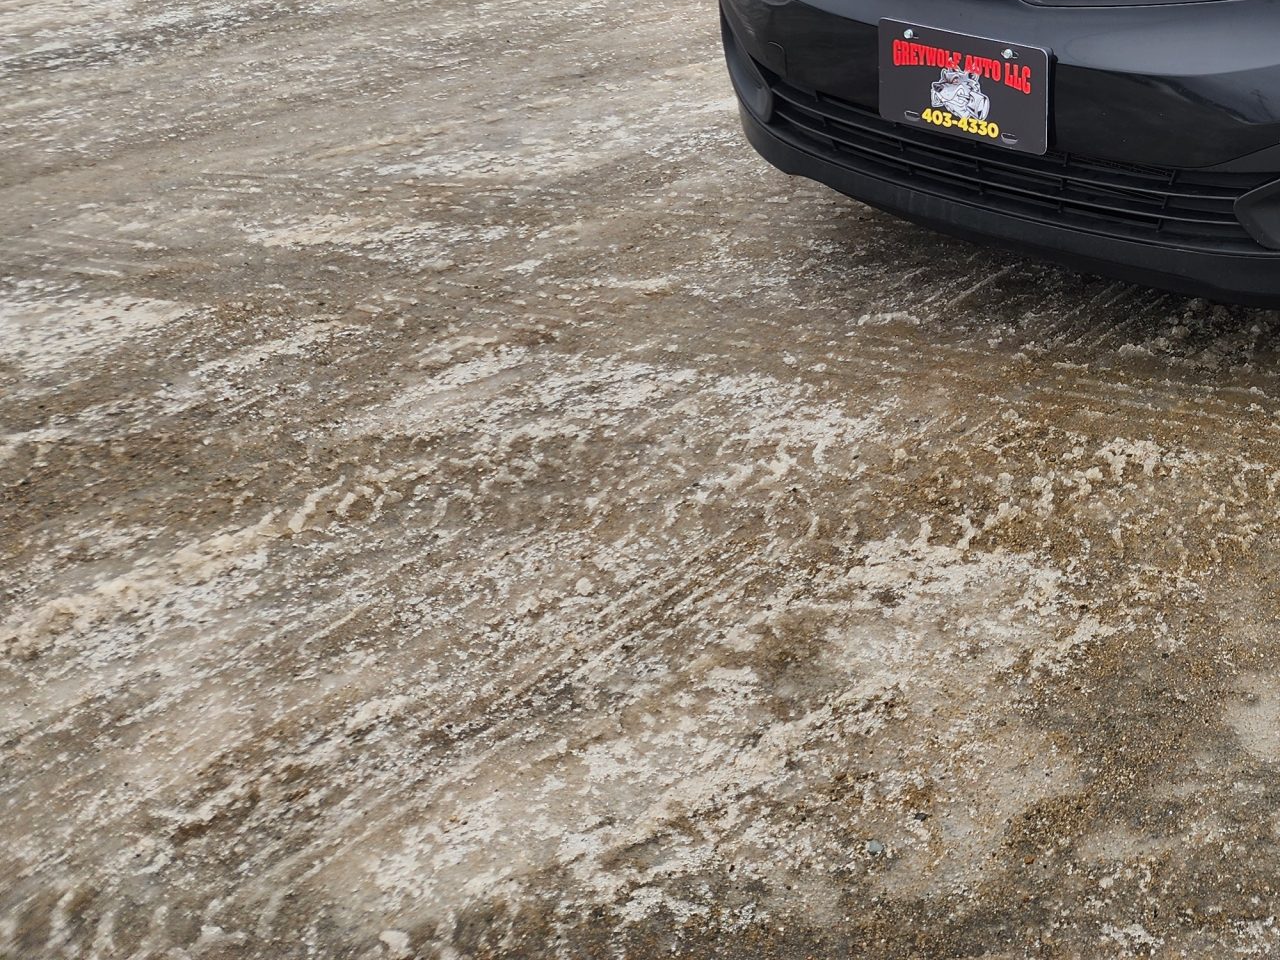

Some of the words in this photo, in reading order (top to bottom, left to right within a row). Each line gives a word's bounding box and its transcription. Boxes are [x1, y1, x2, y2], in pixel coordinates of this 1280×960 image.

[893, 39, 962, 70] GREYWOLF
[964, 53, 1001, 81] AUTO
[1004, 63, 1032, 95] LLC
[921, 107, 1000, 139] 403-4330
